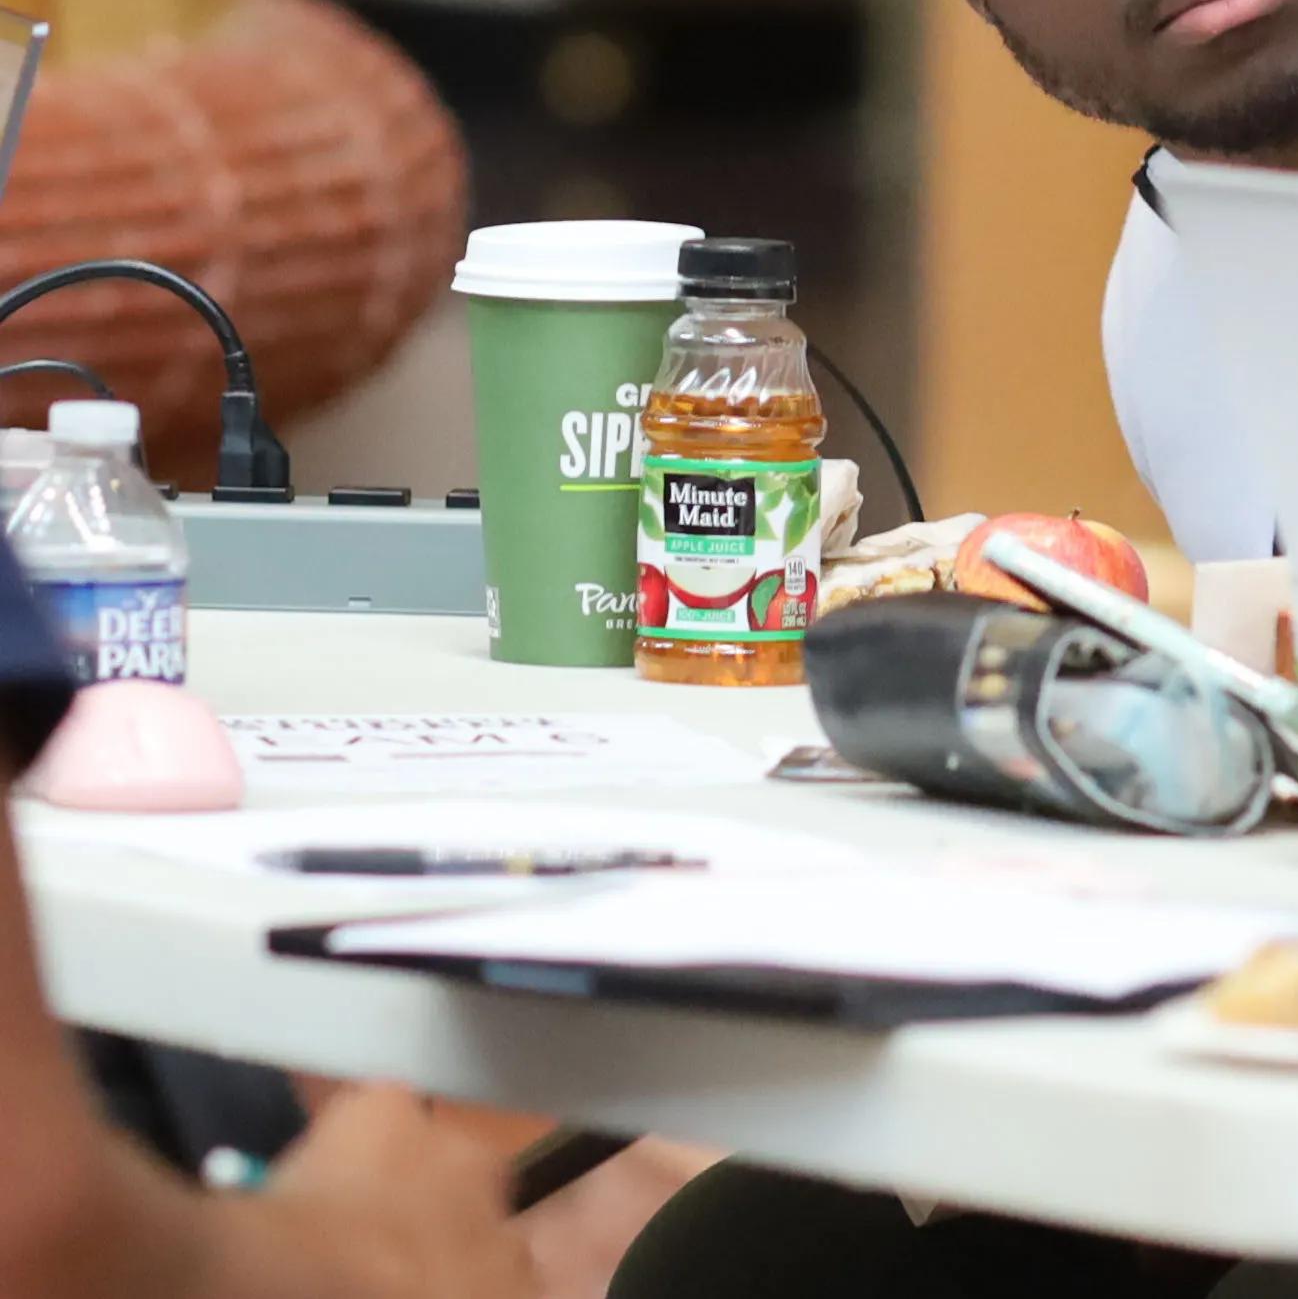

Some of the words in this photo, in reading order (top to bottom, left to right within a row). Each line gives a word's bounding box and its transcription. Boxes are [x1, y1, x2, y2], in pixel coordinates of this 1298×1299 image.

[560, 410, 653, 479] SIPP
[669, 482, 748, 506] Minute
[678, 504, 736, 527] Maid
[671, 539, 704, 552] APPLE
[709, 541, 746, 553] JUICE
[788, 561, 803, 575] 140
[575, 583, 637, 616] Pan
